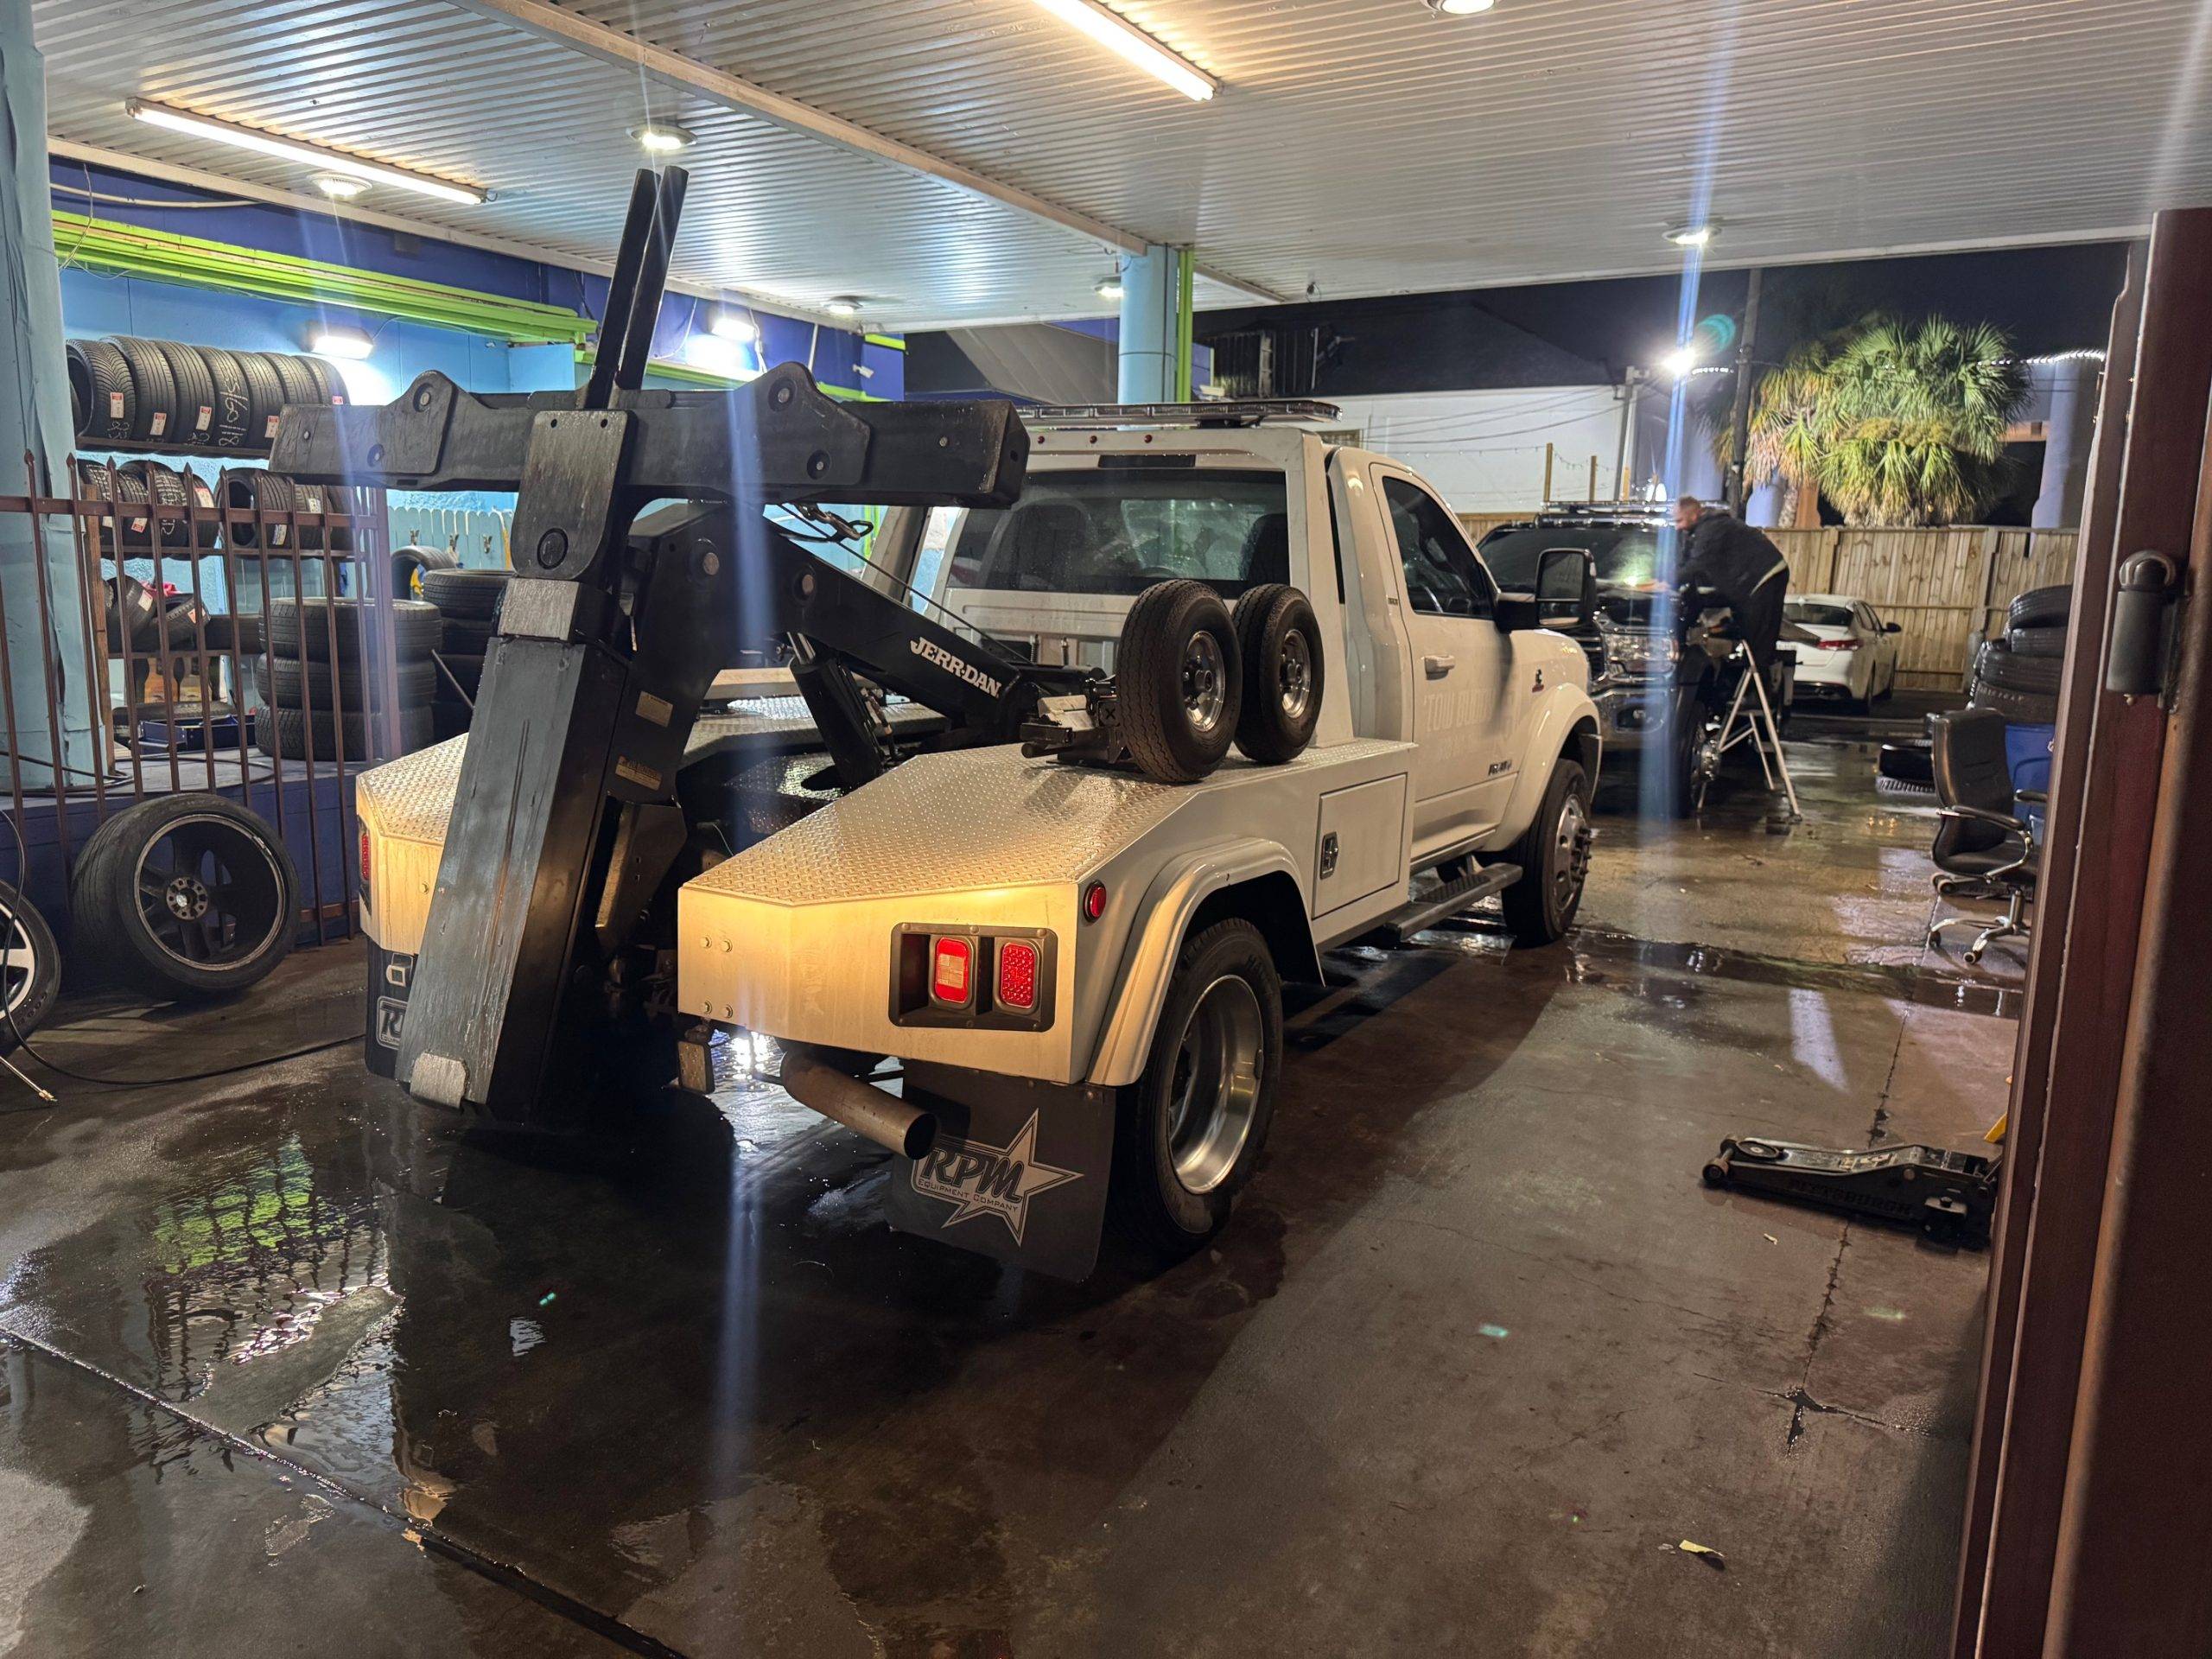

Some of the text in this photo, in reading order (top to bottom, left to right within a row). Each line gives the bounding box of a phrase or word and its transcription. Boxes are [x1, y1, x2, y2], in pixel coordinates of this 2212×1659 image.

[918, 1178, 1019, 1211] EQUIPMENT COMPANY
[921, 1147, 1023, 1204] RPM
